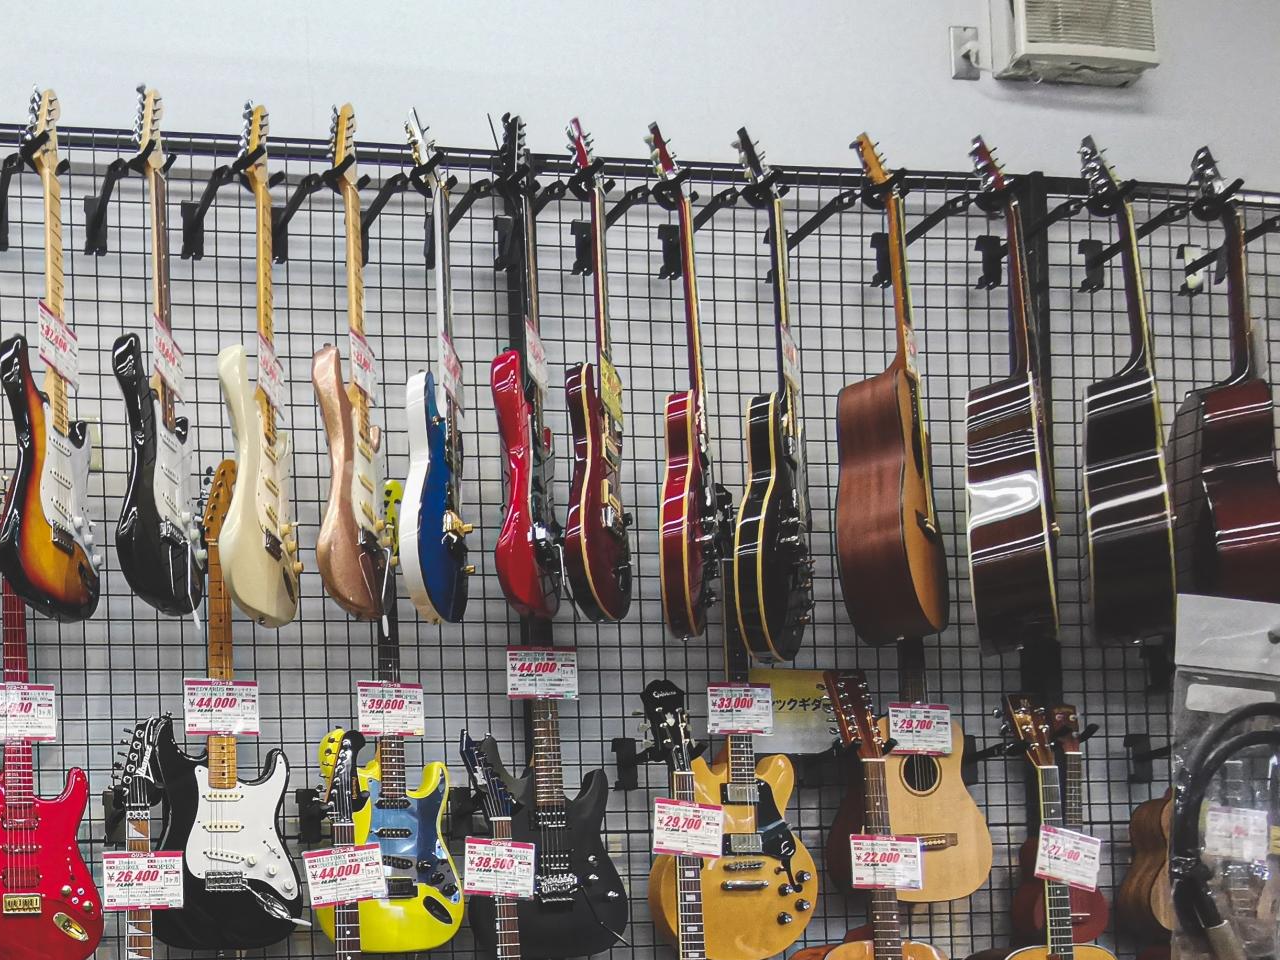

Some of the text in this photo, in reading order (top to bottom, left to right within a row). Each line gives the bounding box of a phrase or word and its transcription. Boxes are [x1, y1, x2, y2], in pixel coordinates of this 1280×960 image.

[136, 744, 152, 778] Ibanez
[658, 815, 702, 830] ¥29,700
[107, 870, 160, 882] ¥26,400
[311, 862, 361, 880] ¥44,000
